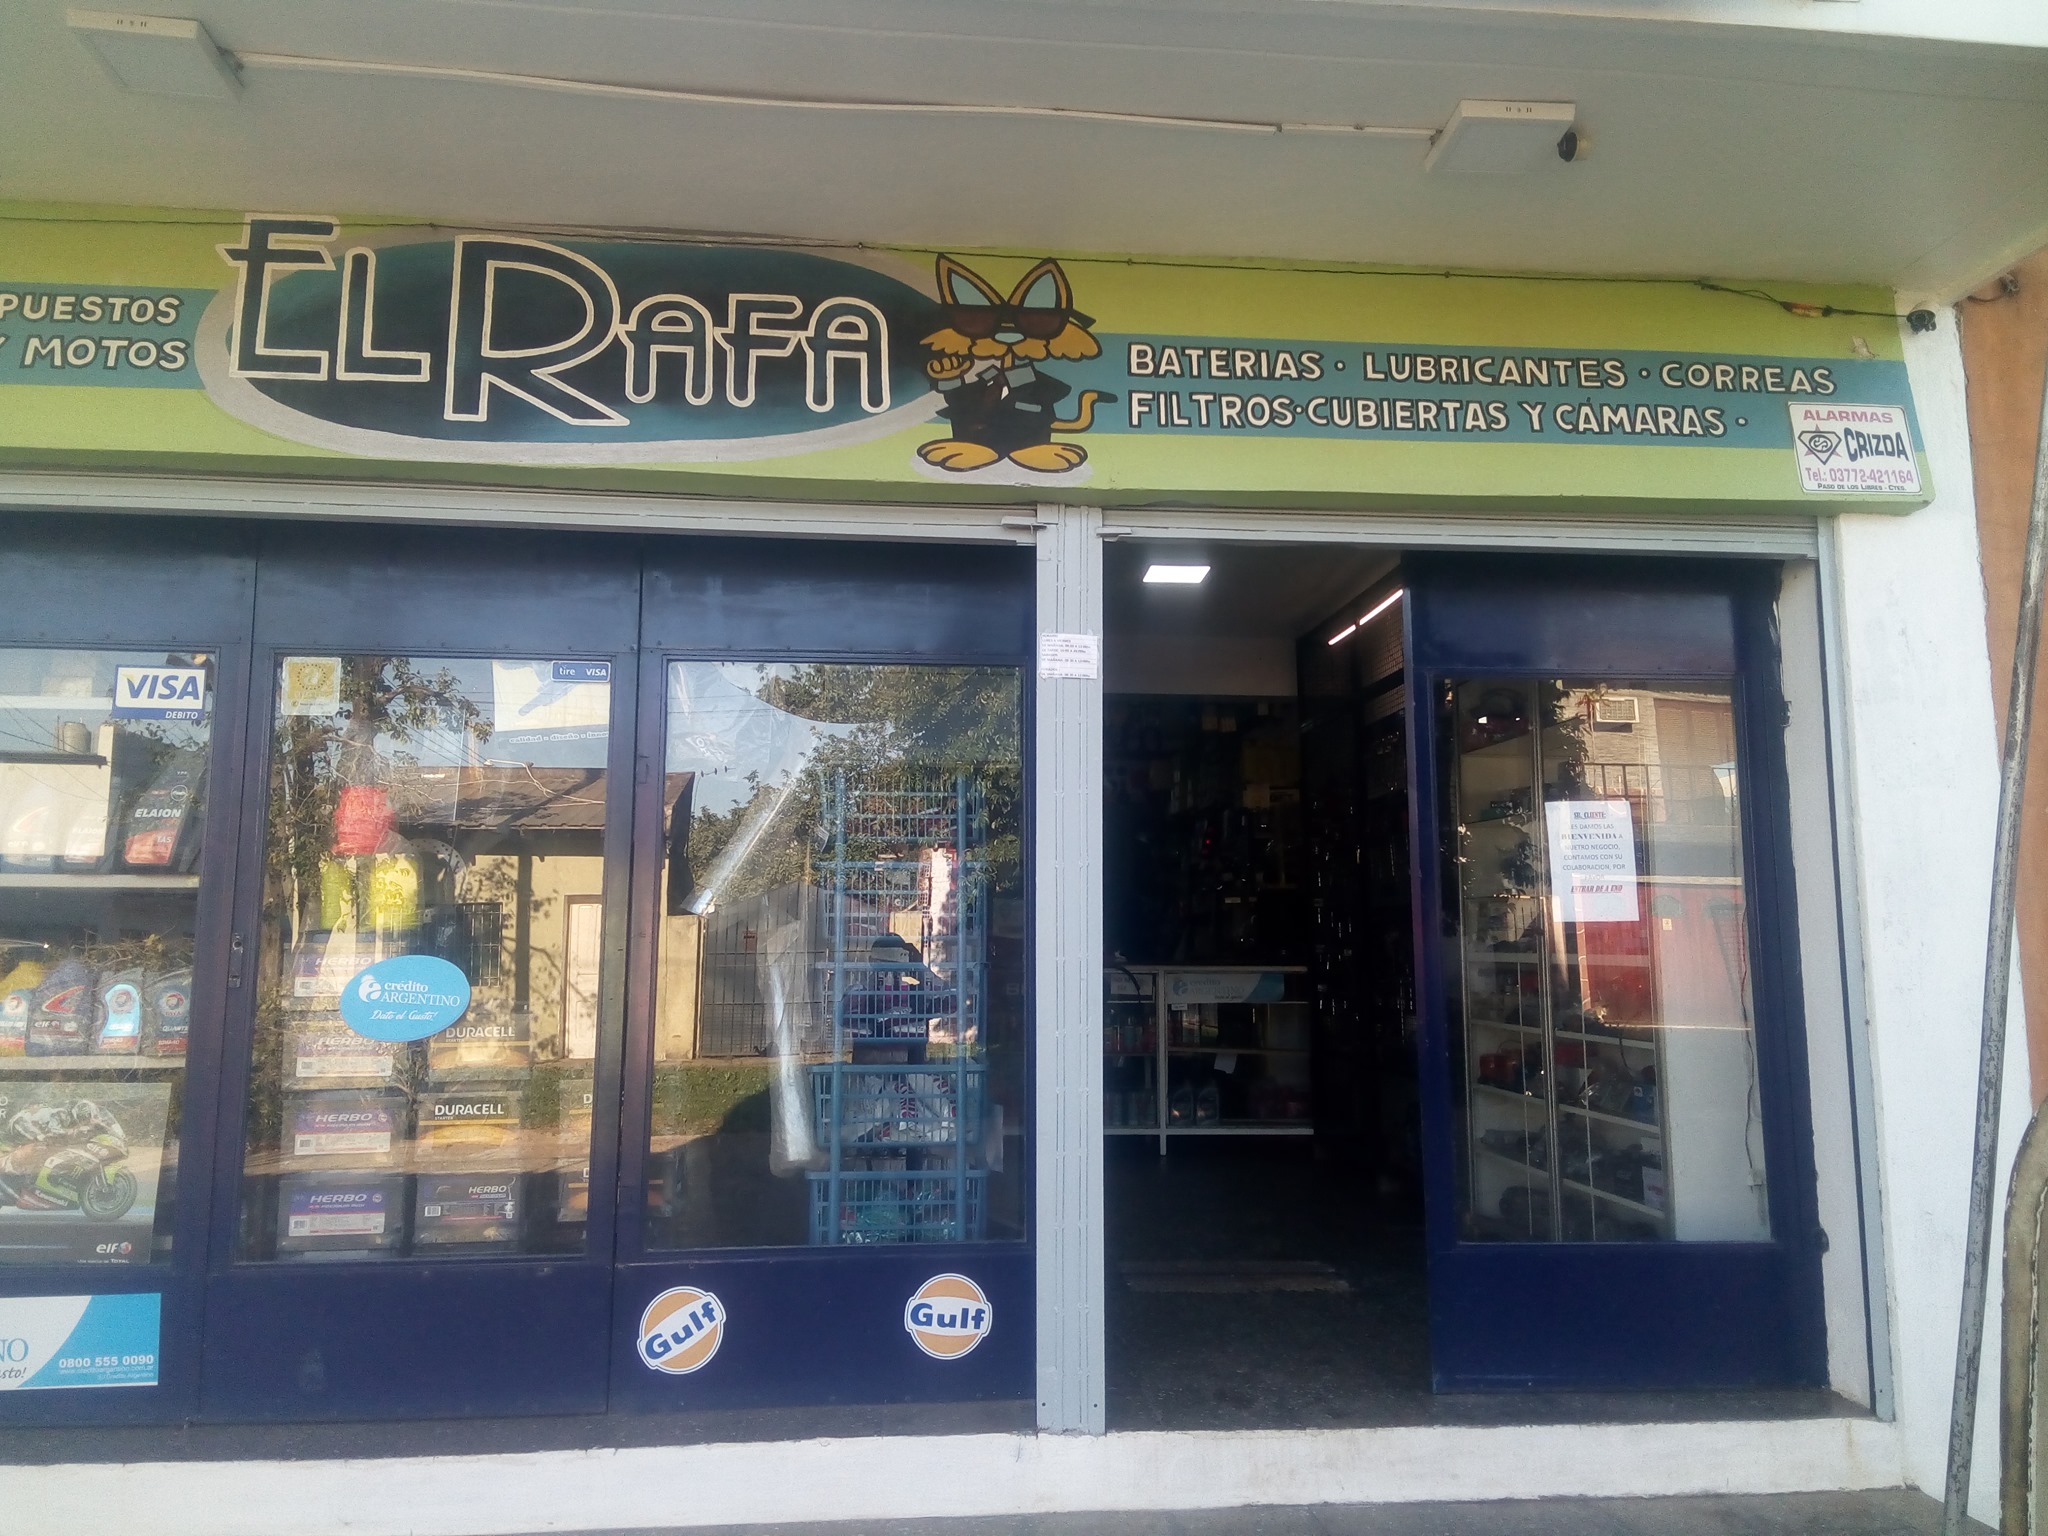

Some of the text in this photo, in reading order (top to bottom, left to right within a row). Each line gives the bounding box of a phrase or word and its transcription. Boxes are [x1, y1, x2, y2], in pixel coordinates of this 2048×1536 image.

[216, 212, 892, 426] EL RAFA
[24, 337, 187, 369] MOTOS
[1365, 353, 1626, 387] LUBRICANTES
[1661, 363, 1837, 395] CORREAS
[1523, 402, 1544, 432] Y
[1803, 409, 1893, 423] ALARMAS
[1843, 427, 1910, 463] CRIZDA
[1829, 468, 1914, 484] 03772-421164
[585, 668, 607, 676] VISA
[126, 673, 200, 700] VISA
[165, 711, 199, 720] DEBITO
[135, 808, 182, 818] ELAION
[384, 980, 429, 992] crédito
[380, 992, 460, 1007] ARGENTINO
[446, 1026, 515, 1038] DURACELL
[434, 1103, 505, 1116] DURACELL
[315, 1113, 373, 1123] HERBO
[469, 1185, 508, 1194] HERBO
[310, 1193, 368, 1204] HERBO
[95, 1243, 119, 1254] elf
[910, 1302, 986, 1330] Gulf
[644, 1301, 717, 1360] Gulf
[59, 1354, 154, 1368] 0800 555 0090
